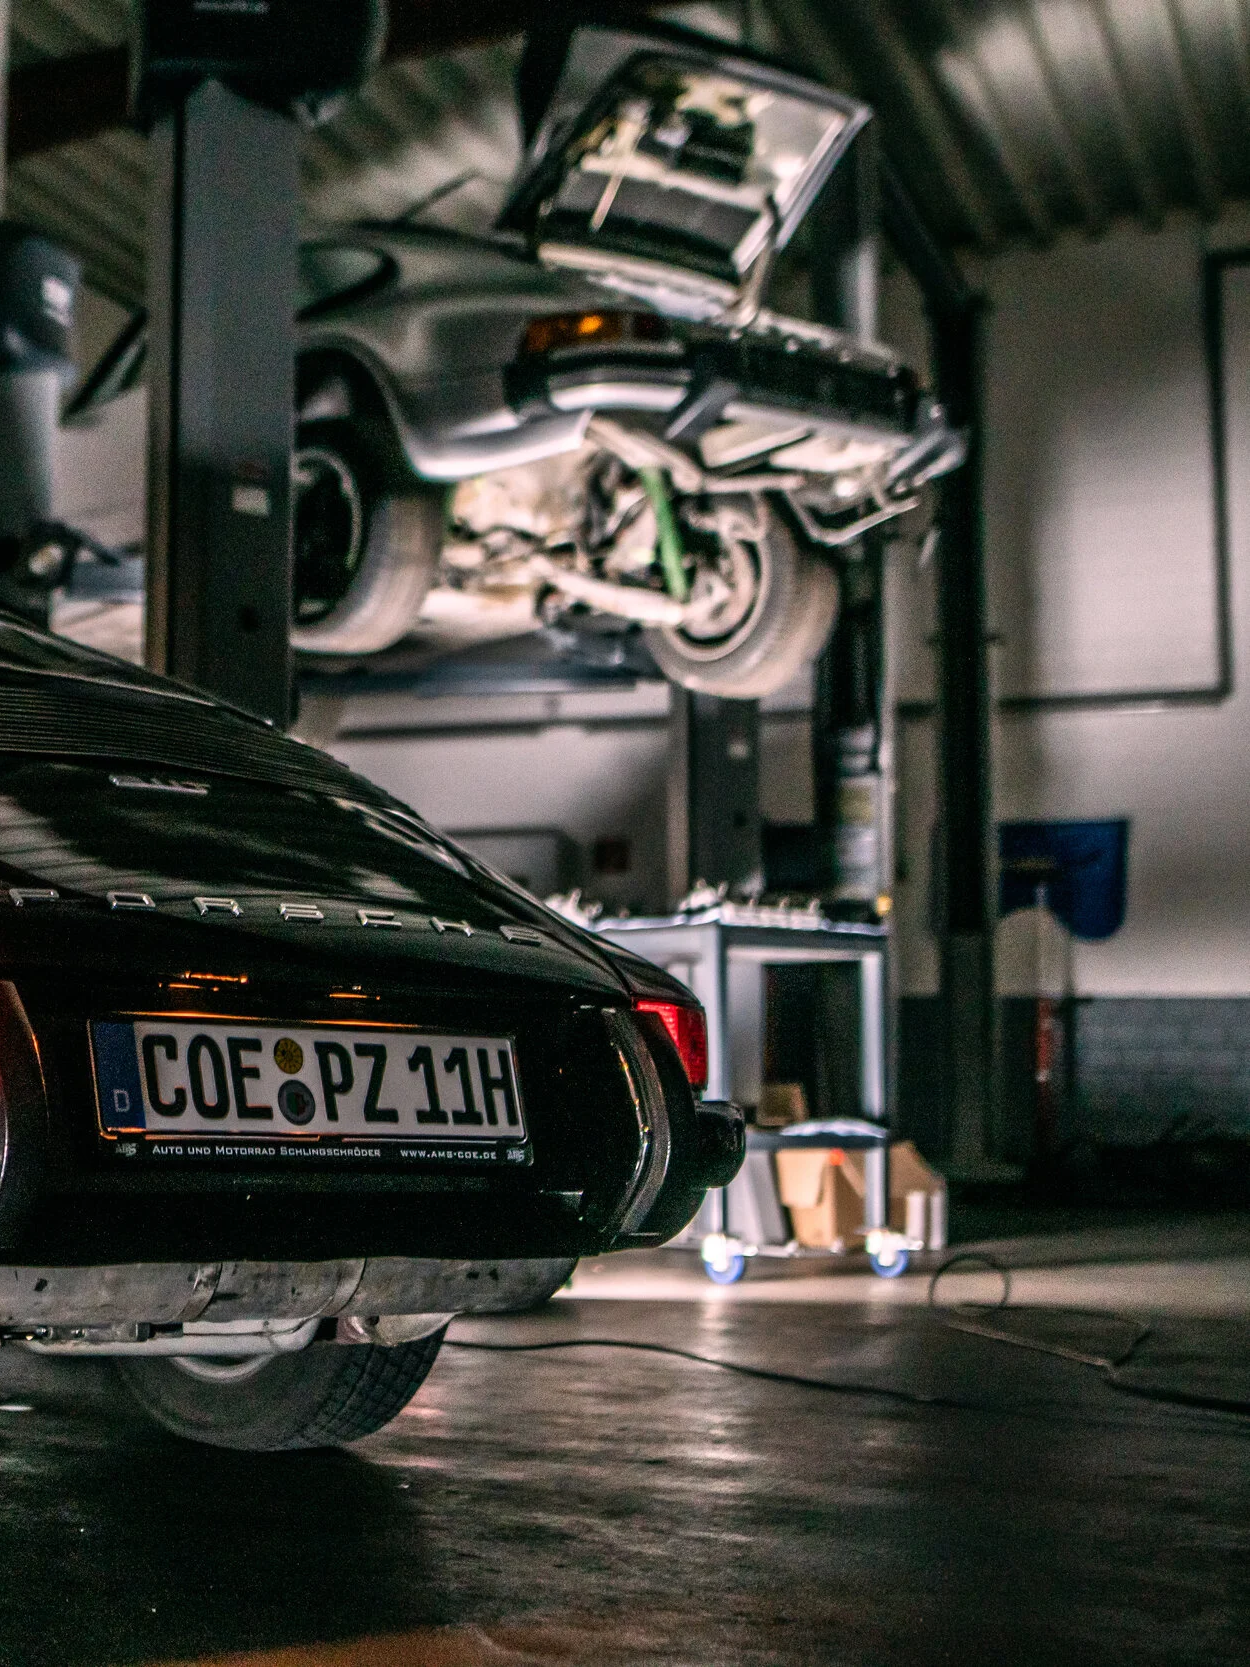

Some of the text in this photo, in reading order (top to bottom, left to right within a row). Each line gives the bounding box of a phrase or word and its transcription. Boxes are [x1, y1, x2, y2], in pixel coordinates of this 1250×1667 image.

[9, 888, 542, 945] PORSCHE
[114, 1089, 130, 1113] D
[142, 1034, 519, 1125] COE PZ 11H
